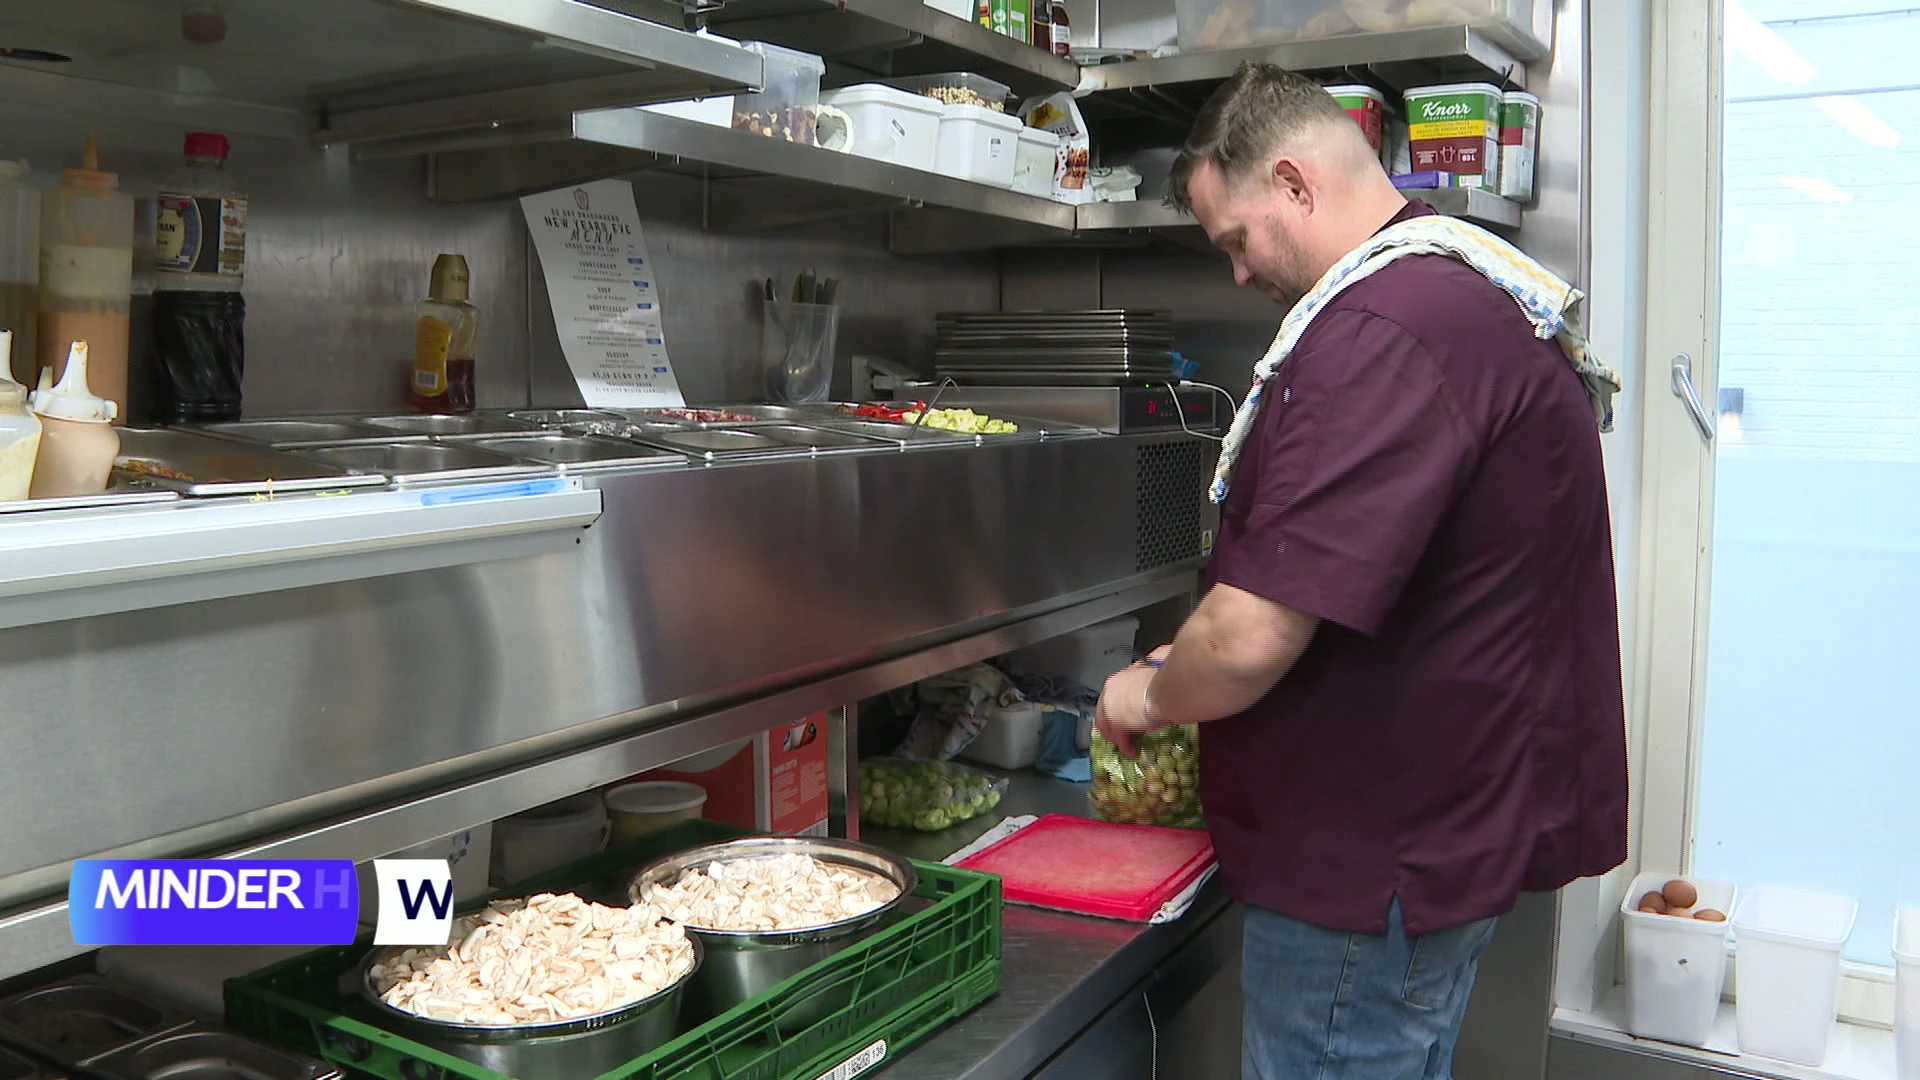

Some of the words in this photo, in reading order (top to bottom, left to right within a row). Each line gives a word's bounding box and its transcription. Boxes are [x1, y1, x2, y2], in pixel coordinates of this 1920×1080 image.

[1421, 101, 1471, 117] Knorr
[544, 215, 568, 228] NEW
[612, 223, 631, 235] EVE
[570, 230, 613, 244] MENU
